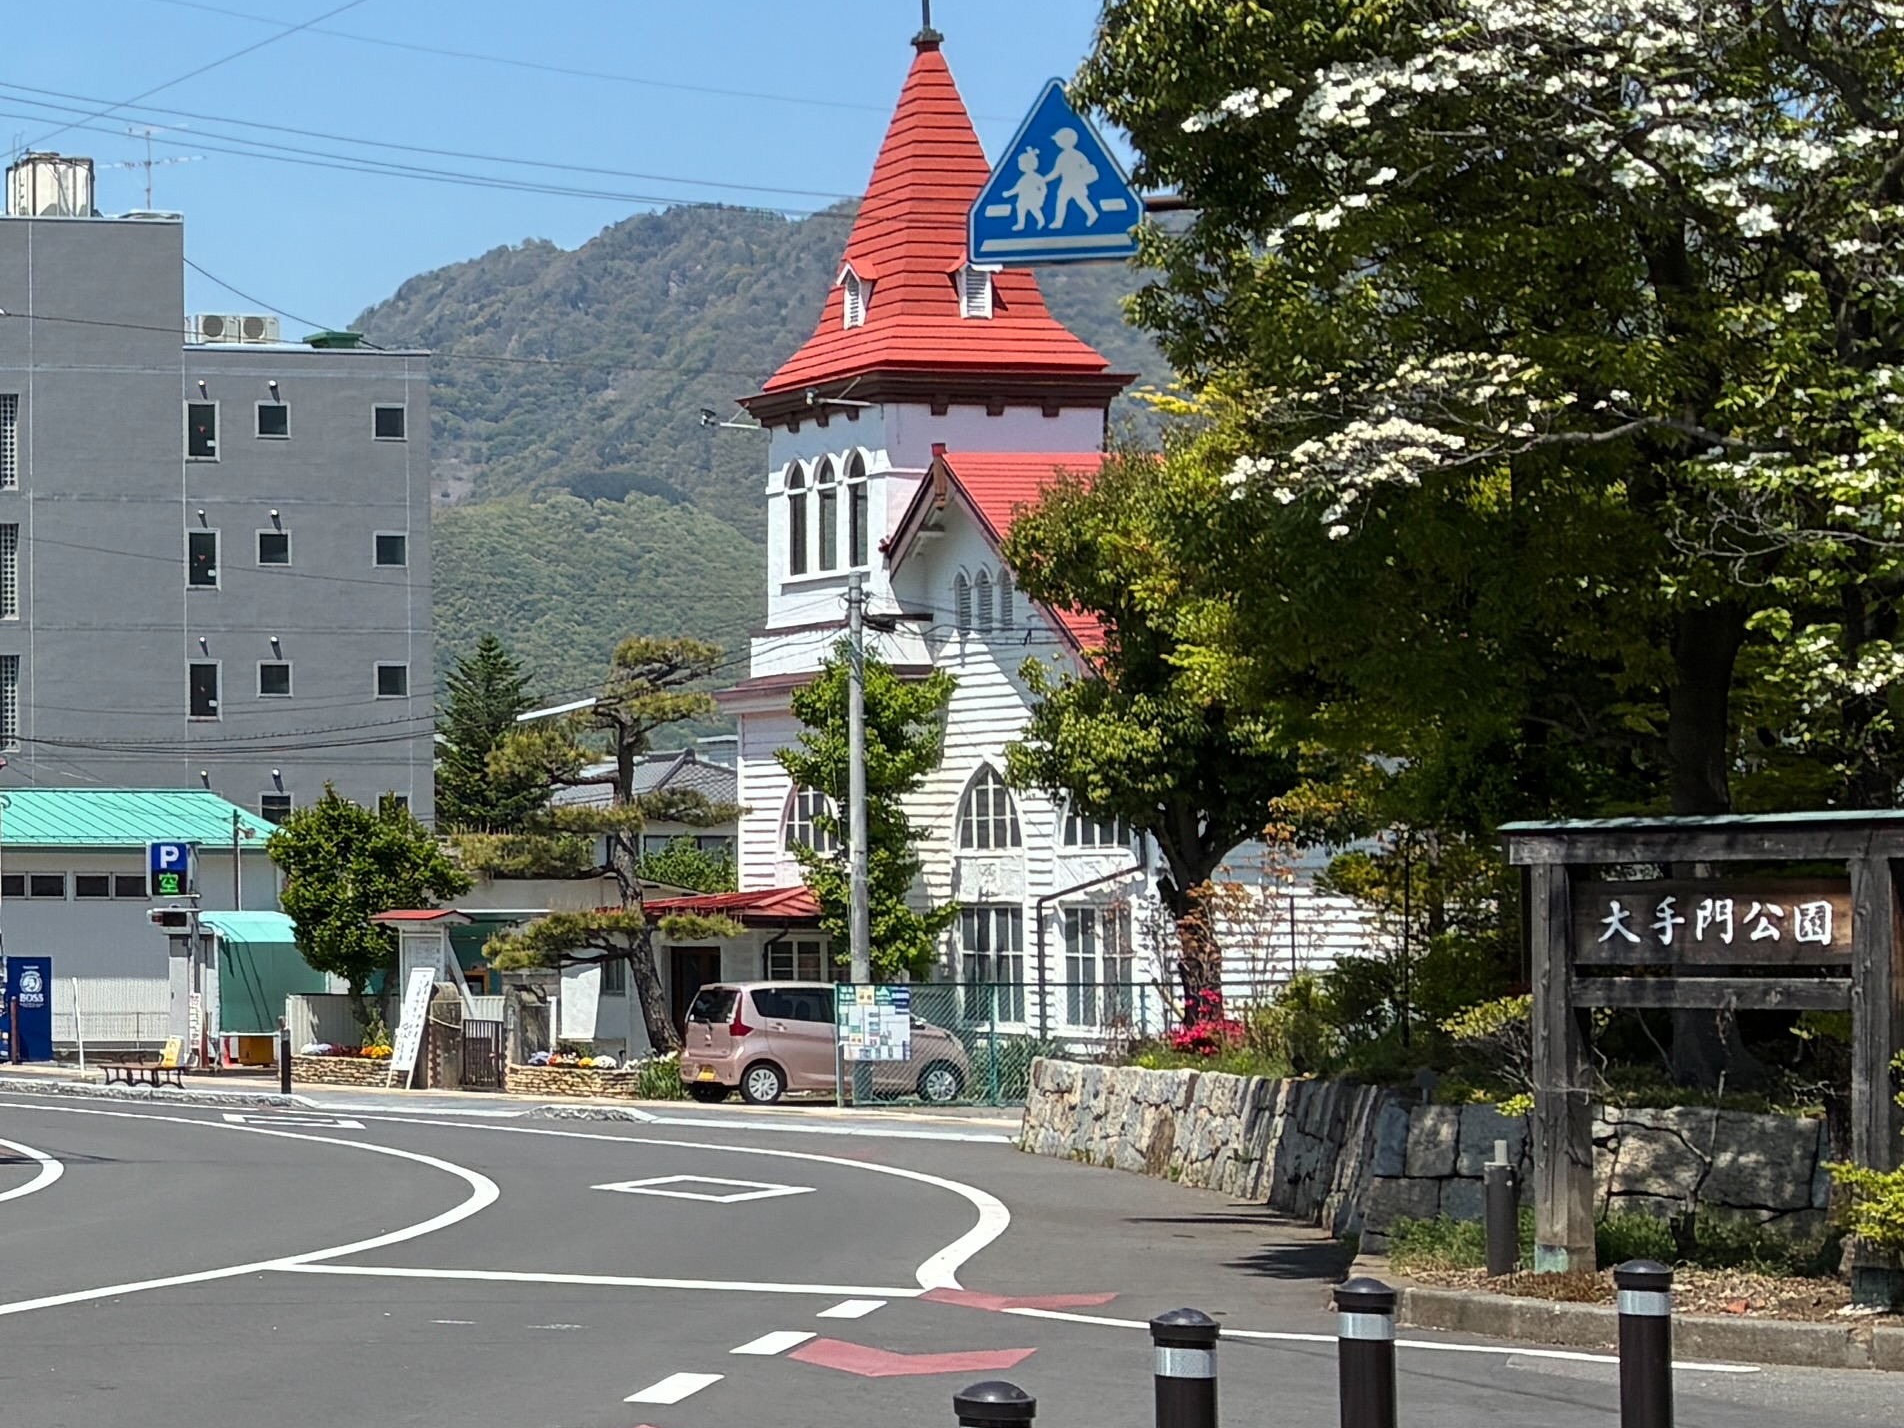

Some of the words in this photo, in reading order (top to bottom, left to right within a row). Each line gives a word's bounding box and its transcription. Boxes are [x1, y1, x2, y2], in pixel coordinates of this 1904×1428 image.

[160, 846, 179, 869] P
[1597, 895, 1833, 946] 大手門公園
[19, 993, 44, 1003] BOSS
